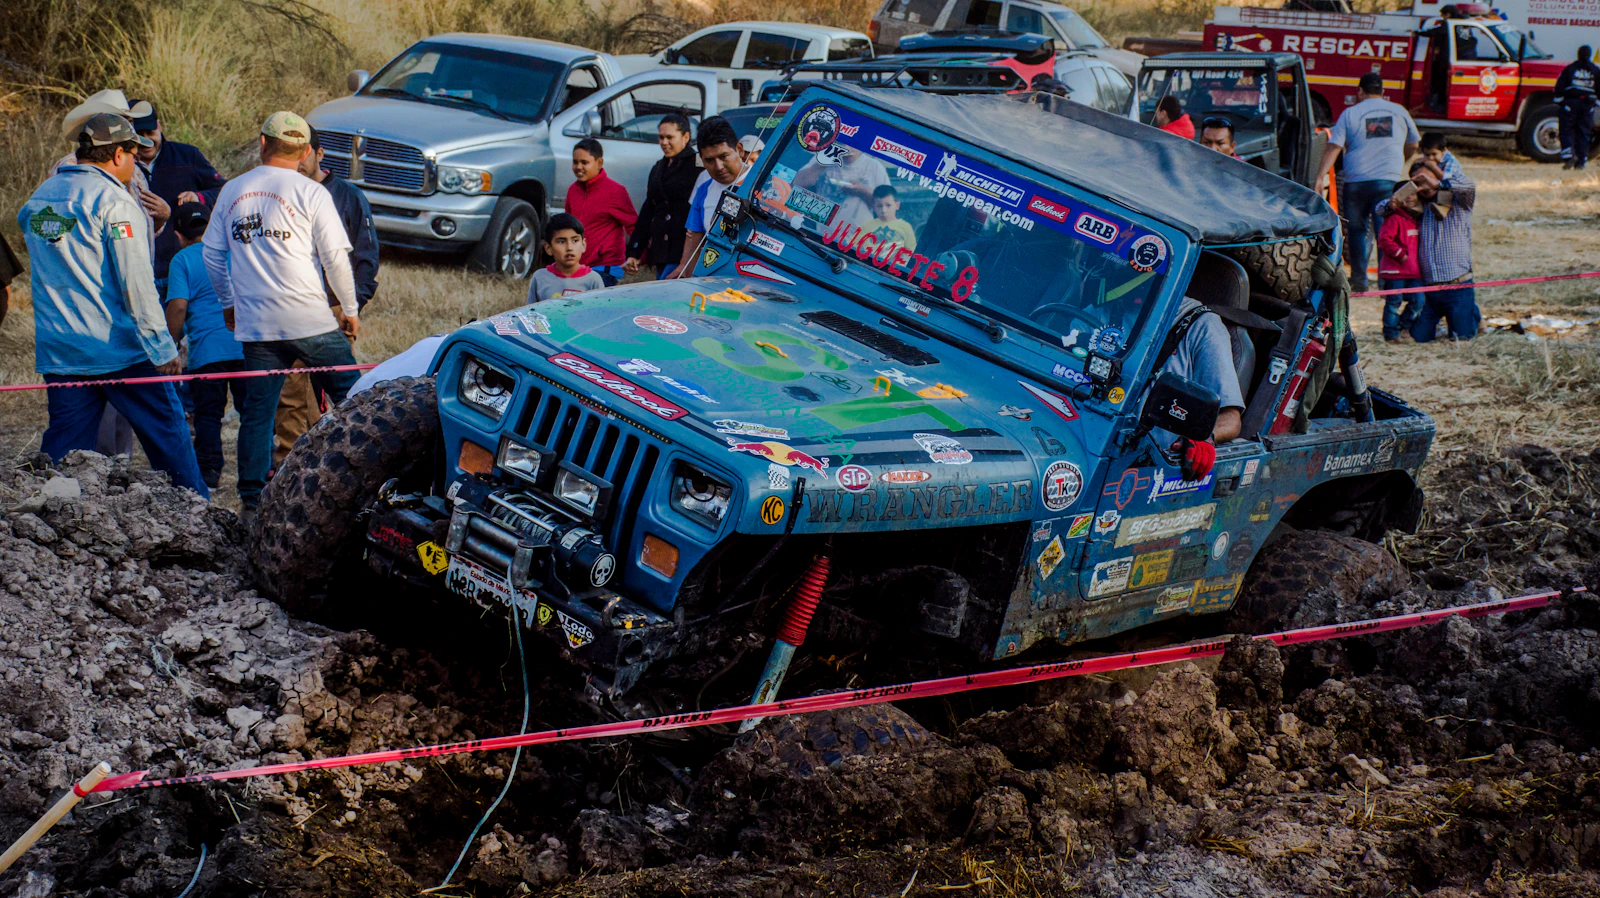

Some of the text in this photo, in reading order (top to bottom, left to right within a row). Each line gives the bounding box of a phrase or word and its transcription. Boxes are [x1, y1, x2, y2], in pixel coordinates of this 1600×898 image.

[1527, 16, 1568, 26] URGENCIAS
[1282, 34, 1409, 59] RESCATE
[872, 138, 926, 167] SKYJACKER
[955, 169, 1022, 202] MICHELIN
[256, 226, 292, 242] Jeep
[1079, 215, 1116, 241] ARB
[822, 220, 980, 302] JUGUETE 8
[554, 358, 679, 418] Edelbrock
[1322, 451, 1375, 472] Banamex
[842, 468, 868, 487] STP
[887, 471, 925, 483] MAXXIS
[763, 497, 782, 523] KC
[805, 479, 1035, 523] WRANGLER
[1128, 508, 1206, 535] BFGoodrich
[470, 570, 488, 585] Estado
[487, 579, 495, 588] de
[564, 616, 593, 640] Lodo
